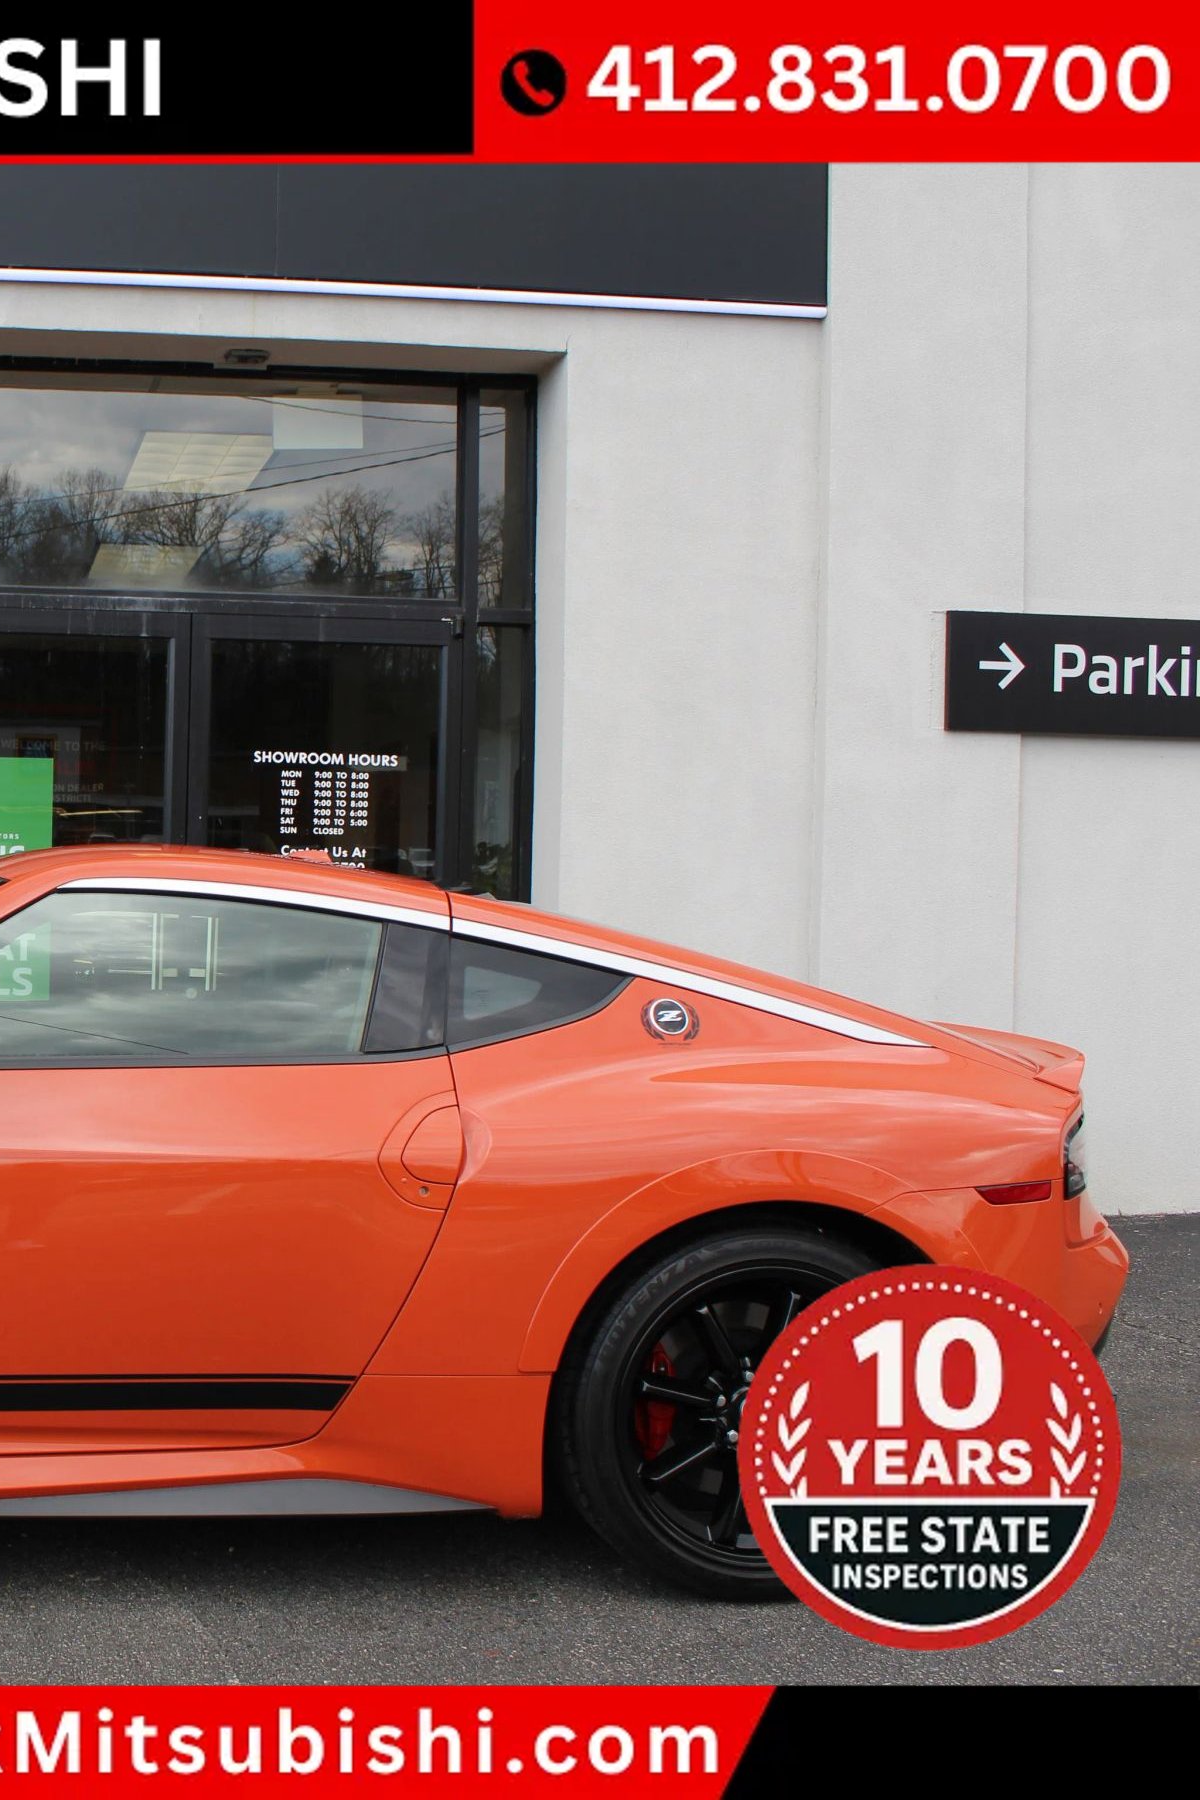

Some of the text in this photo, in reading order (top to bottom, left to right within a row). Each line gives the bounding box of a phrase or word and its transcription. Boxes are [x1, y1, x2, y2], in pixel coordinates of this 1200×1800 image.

[1054, 643, 1200, 697] Parki
[65, 741, 80, 751] TO
[253, 751, 399, 767] SHOWROOM HOURS
[281, 770, 369, 780] MON 9:00 TO 8:00
[314, 780, 332, 788] 9:00
[336, 781, 346, 789] TO
[351, 782, 369, 790] 8:00
[314, 790, 332, 798] 9:00
[350, 791, 369, 799] 8:00
[314, 799, 332, 807] 9:00
[336, 800, 346, 808] TO
[314, 809, 331, 817] 9:00
[335, 809, 346, 817] TO
[350, 810, 368, 818] 6:00
[280, 817, 295, 825] SAT
[313, 818, 330, 826] 9:00
[350, 819, 368, 827] 5:00
[280, 826, 298, 834] SUN
[332, 846, 348, 858] Us
[351, 847, 366, 858] At
[657, 1010, 683, 1022] Z
